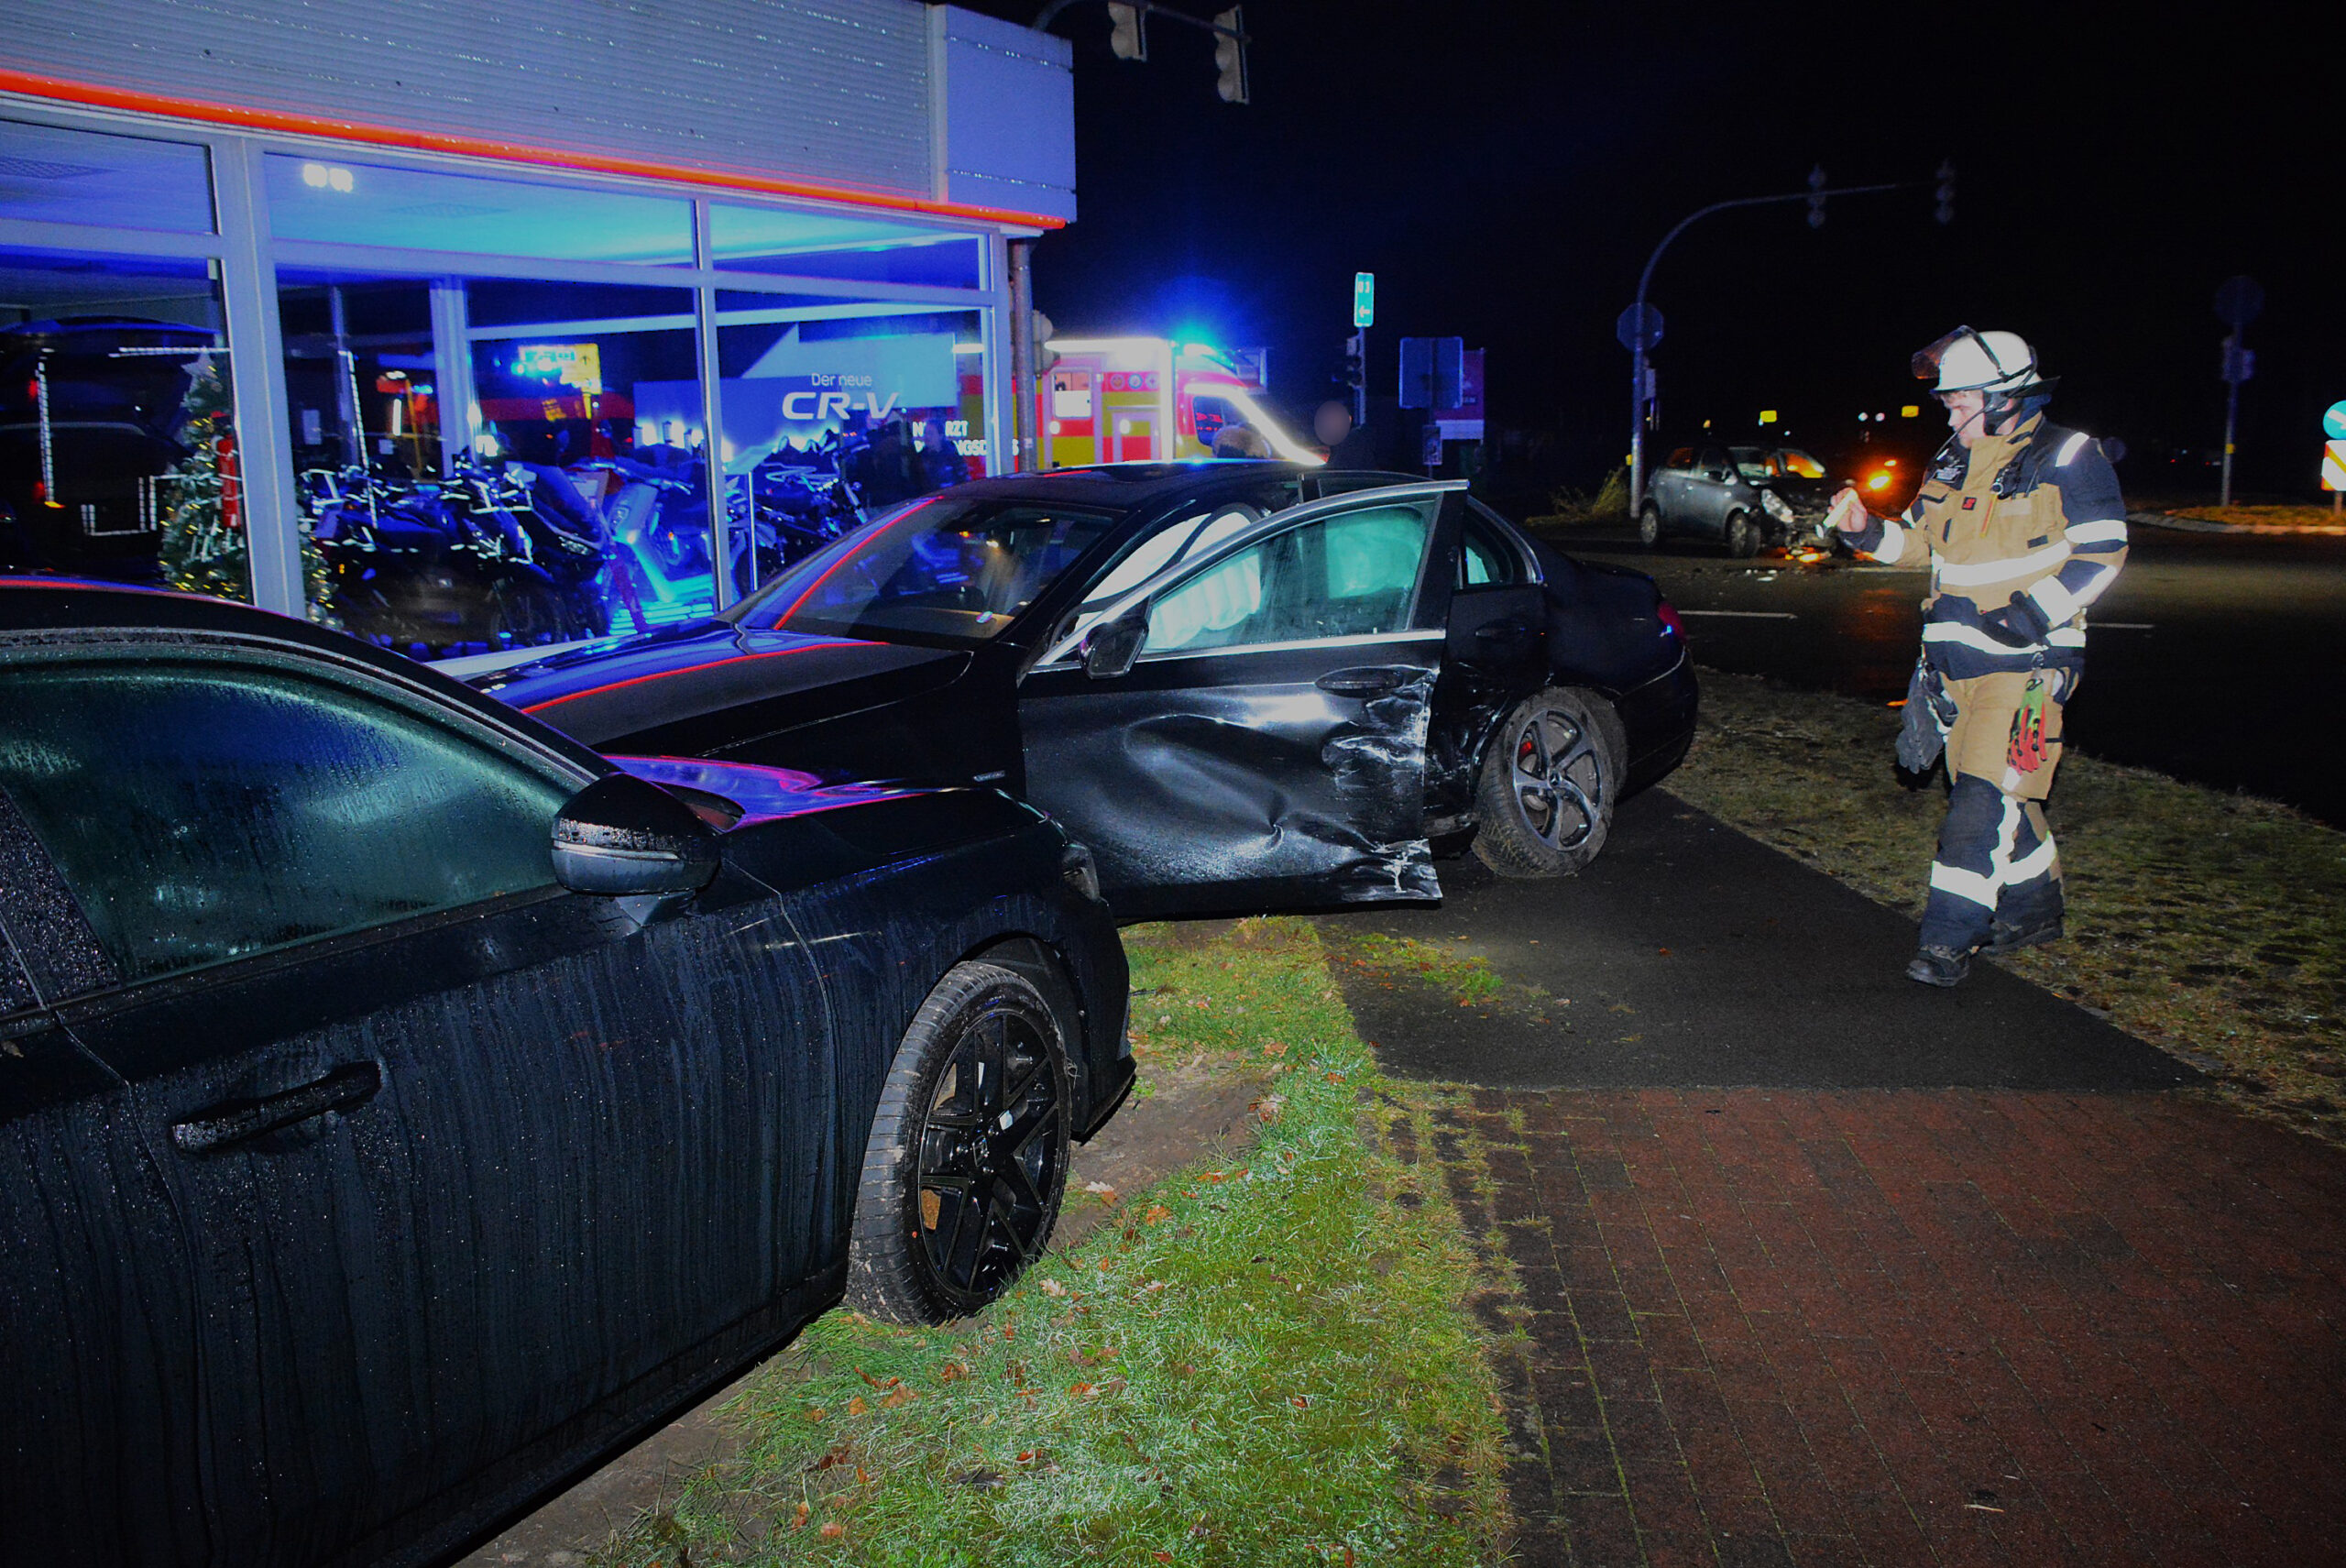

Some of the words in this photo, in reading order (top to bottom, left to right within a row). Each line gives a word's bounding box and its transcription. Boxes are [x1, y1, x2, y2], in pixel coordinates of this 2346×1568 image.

[811, 373, 835, 386] Der
[838, 374, 872, 386] neue
[782, 391, 900, 420] CR-V
